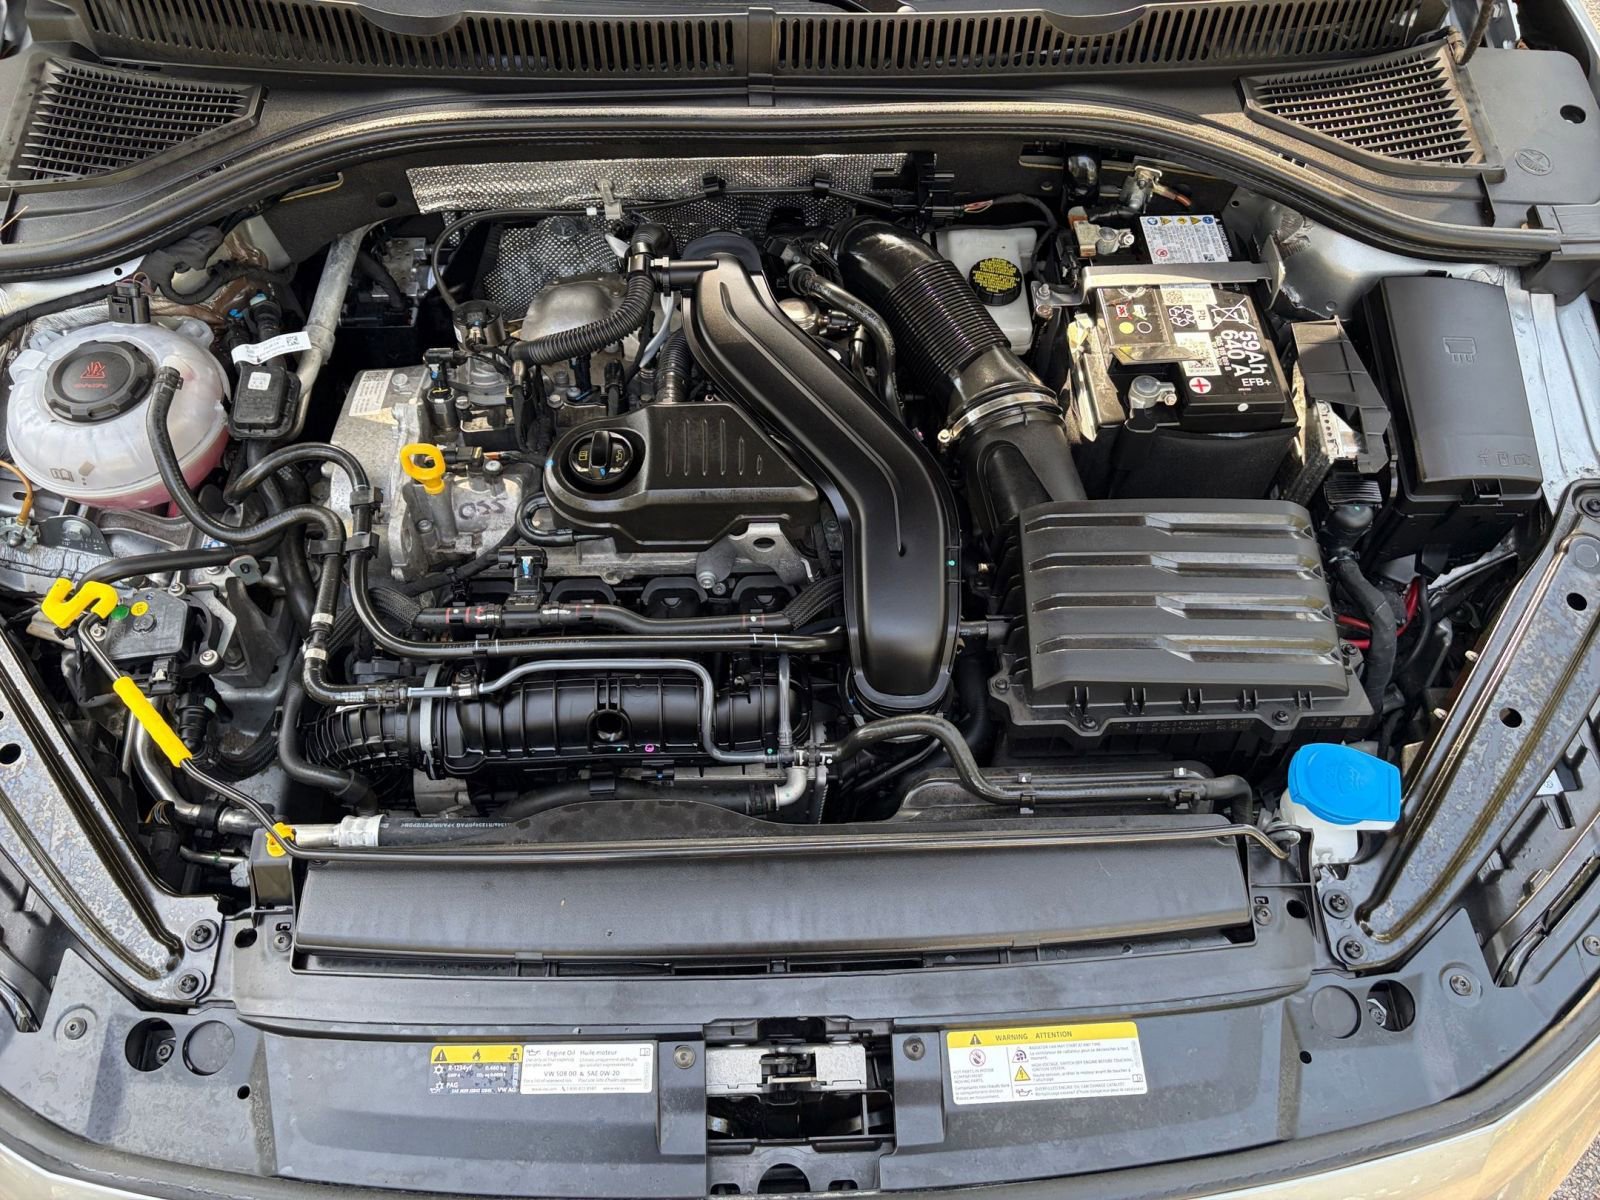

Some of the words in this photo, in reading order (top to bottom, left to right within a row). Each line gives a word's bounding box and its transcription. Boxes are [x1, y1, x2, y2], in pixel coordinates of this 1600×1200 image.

[1197, 309, 1206, 321] Pb
[1221, 329, 1246, 360] 640
[1239, 330, 1268, 375] 59Ah
[1231, 363, 1251, 377] A
[1241, 377, 1272, 387] EFB+
[1035, 1031, 1073, 1039] ATTENTION
